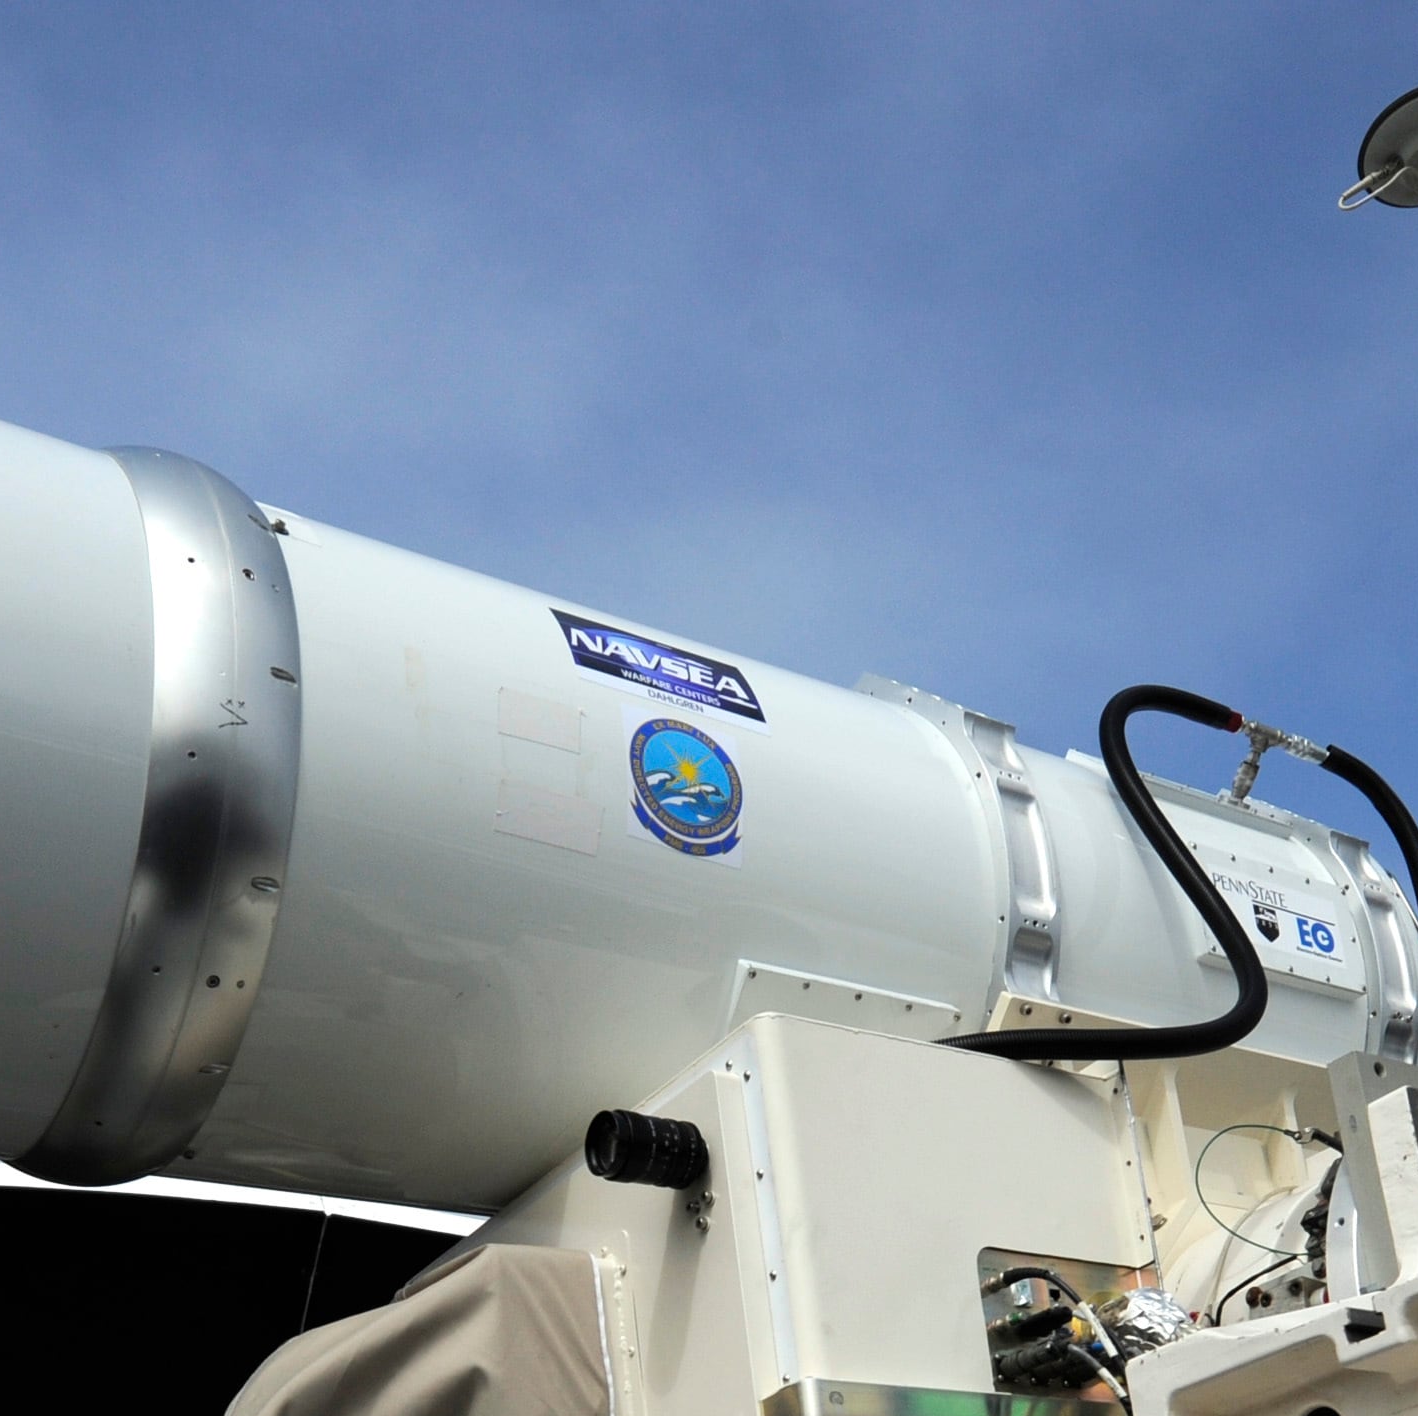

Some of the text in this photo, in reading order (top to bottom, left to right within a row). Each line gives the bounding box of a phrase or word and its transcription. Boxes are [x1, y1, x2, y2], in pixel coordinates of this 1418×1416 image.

[570, 627, 750, 701] NAVSEA
[620, 667, 721, 707] WARFARE CENTERS
[647, 689, 704, 713] DAHLGREN
